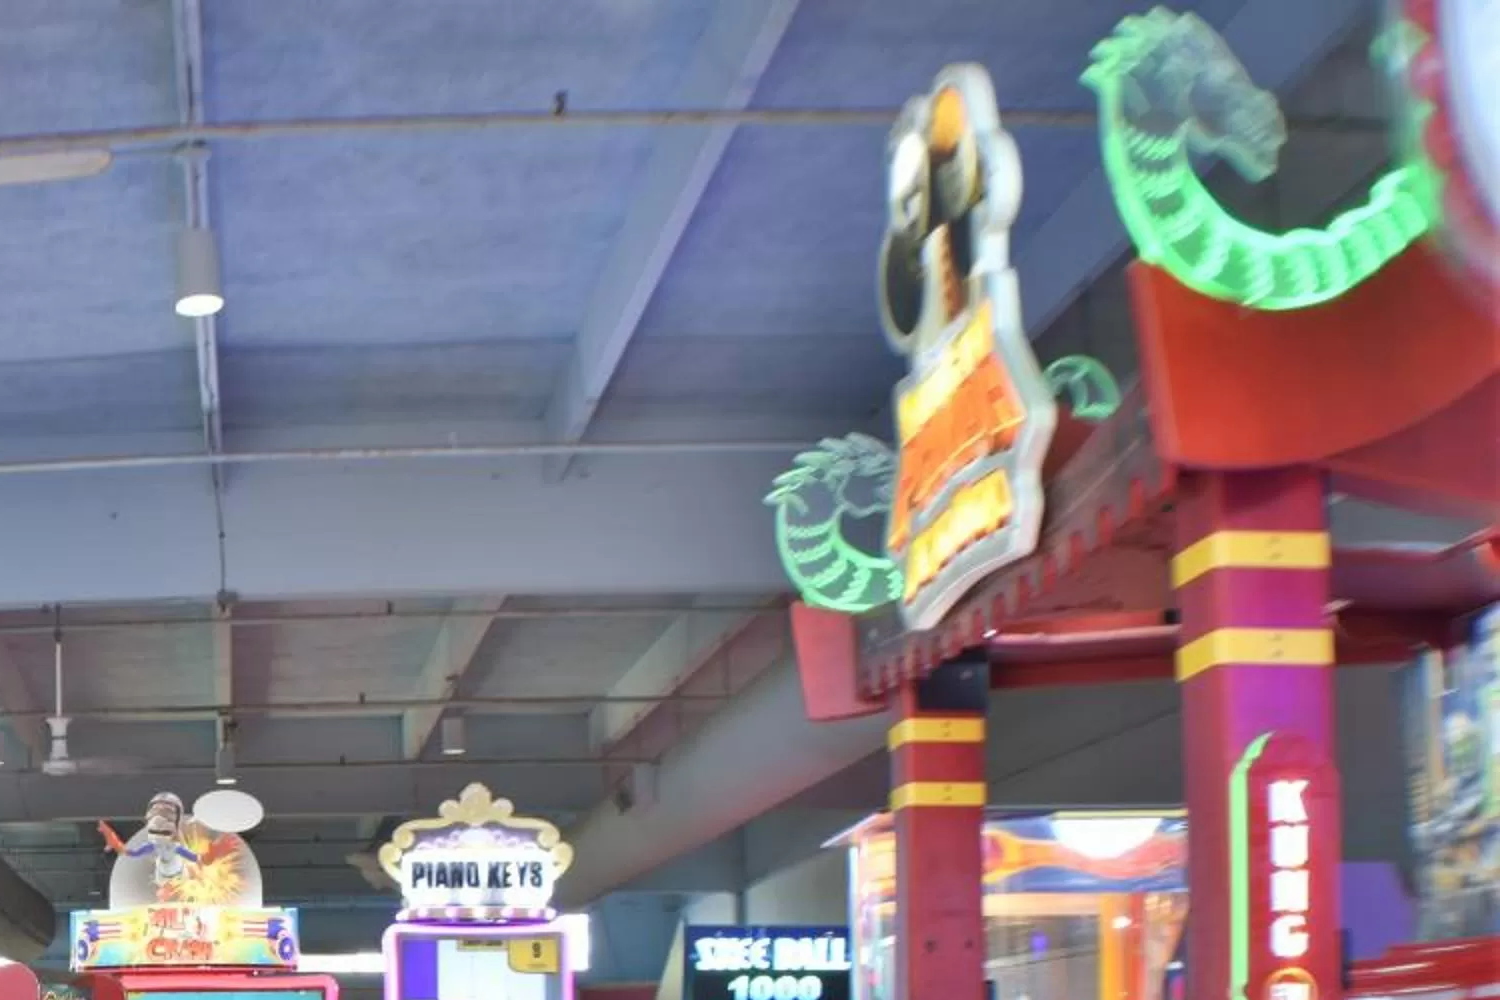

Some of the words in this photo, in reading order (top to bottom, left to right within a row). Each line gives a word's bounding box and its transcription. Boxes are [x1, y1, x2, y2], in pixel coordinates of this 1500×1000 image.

[411, 861, 480, 889] PIANO
[487, 861, 543, 889] KEYS
[1265, 779, 1310, 958] KUNG
[773, 937, 852, 971] BALL
